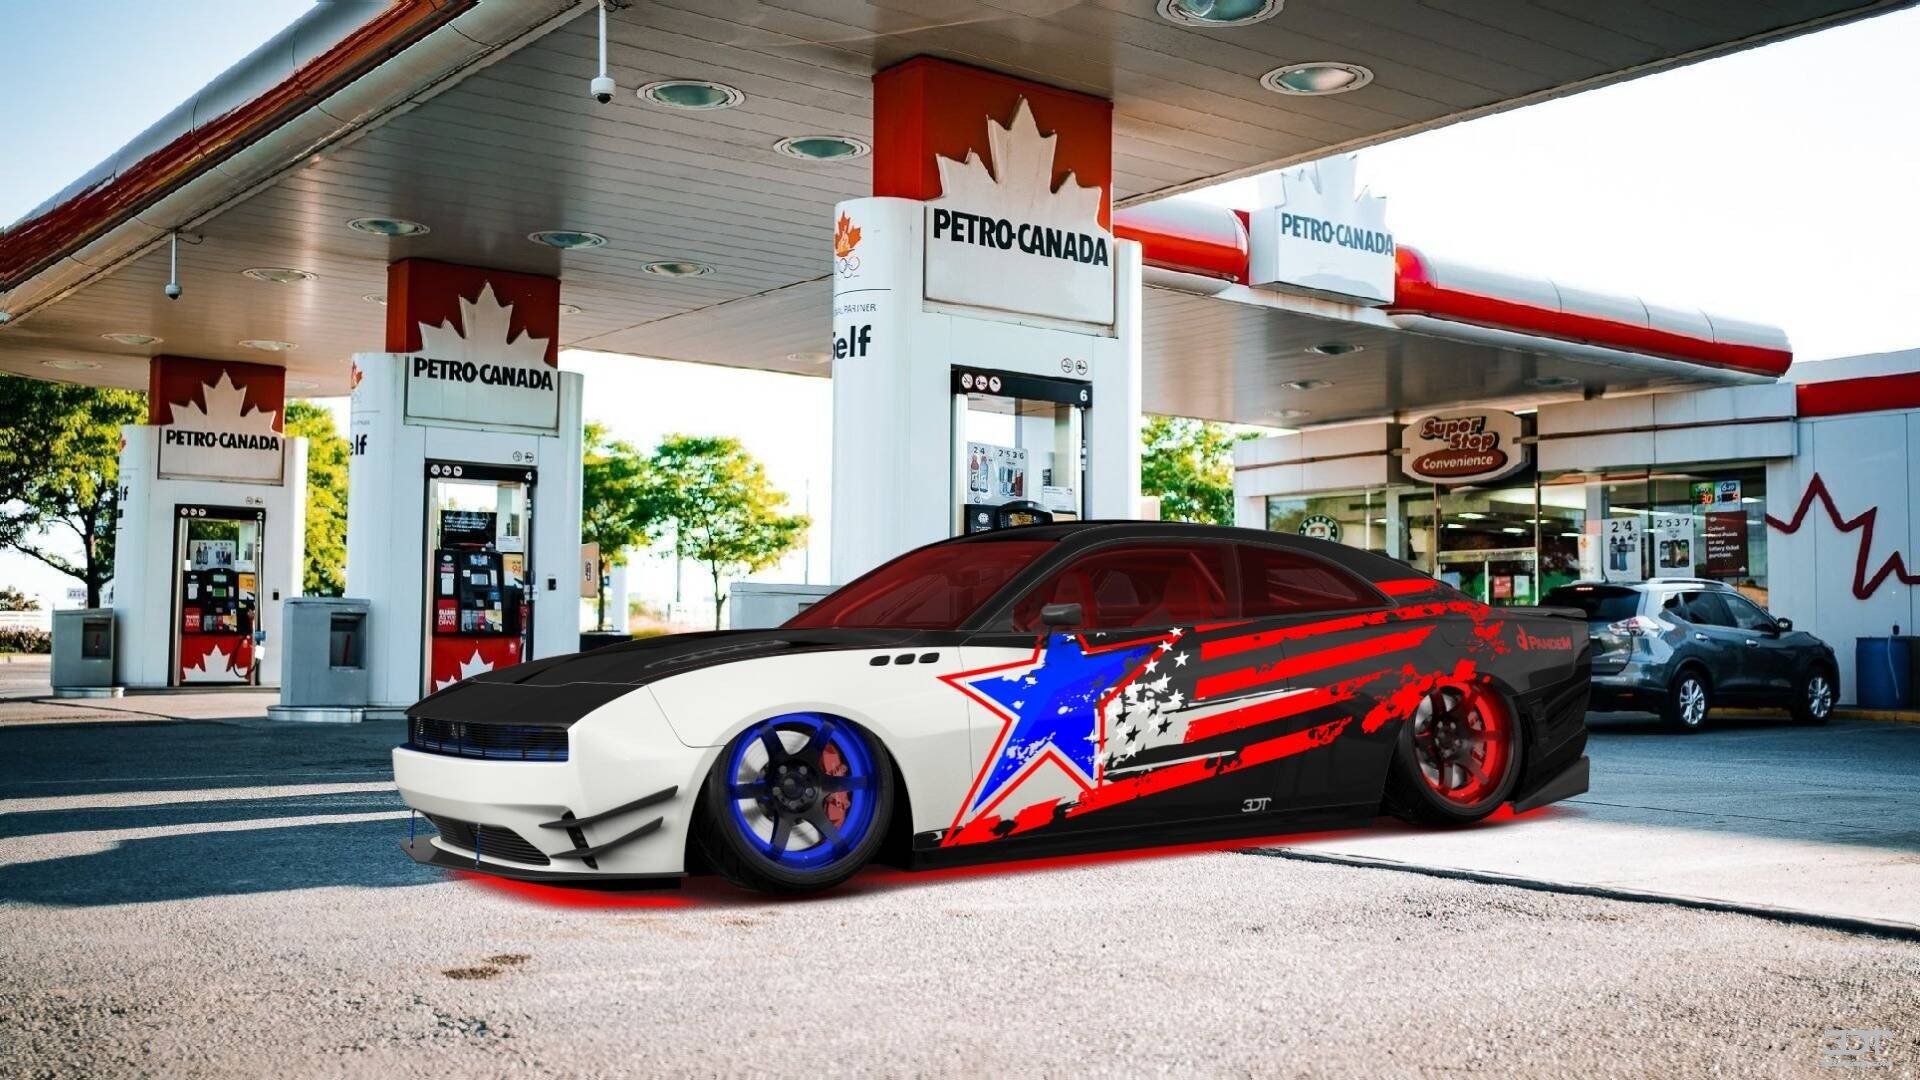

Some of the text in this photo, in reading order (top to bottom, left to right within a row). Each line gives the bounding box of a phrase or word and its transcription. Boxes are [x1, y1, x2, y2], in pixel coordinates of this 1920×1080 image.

[933, 207, 1109, 267] PETRO-CANADA
[1281, 212, 1395, 257] PETRO-CANADA
[413, 356, 554, 391] PETRO-CANADA
[1080, 389, 1088, 402] 6
[165, 428, 280, 451] PETRO-CANADA
[1421, 418, 1483, 440] Super
[1449, 432, 1495, 452] Stop
[1422, 455, 1494, 469] Convenience
[525, 471, 533, 481] 4
[256, 511, 263, 520] 2
